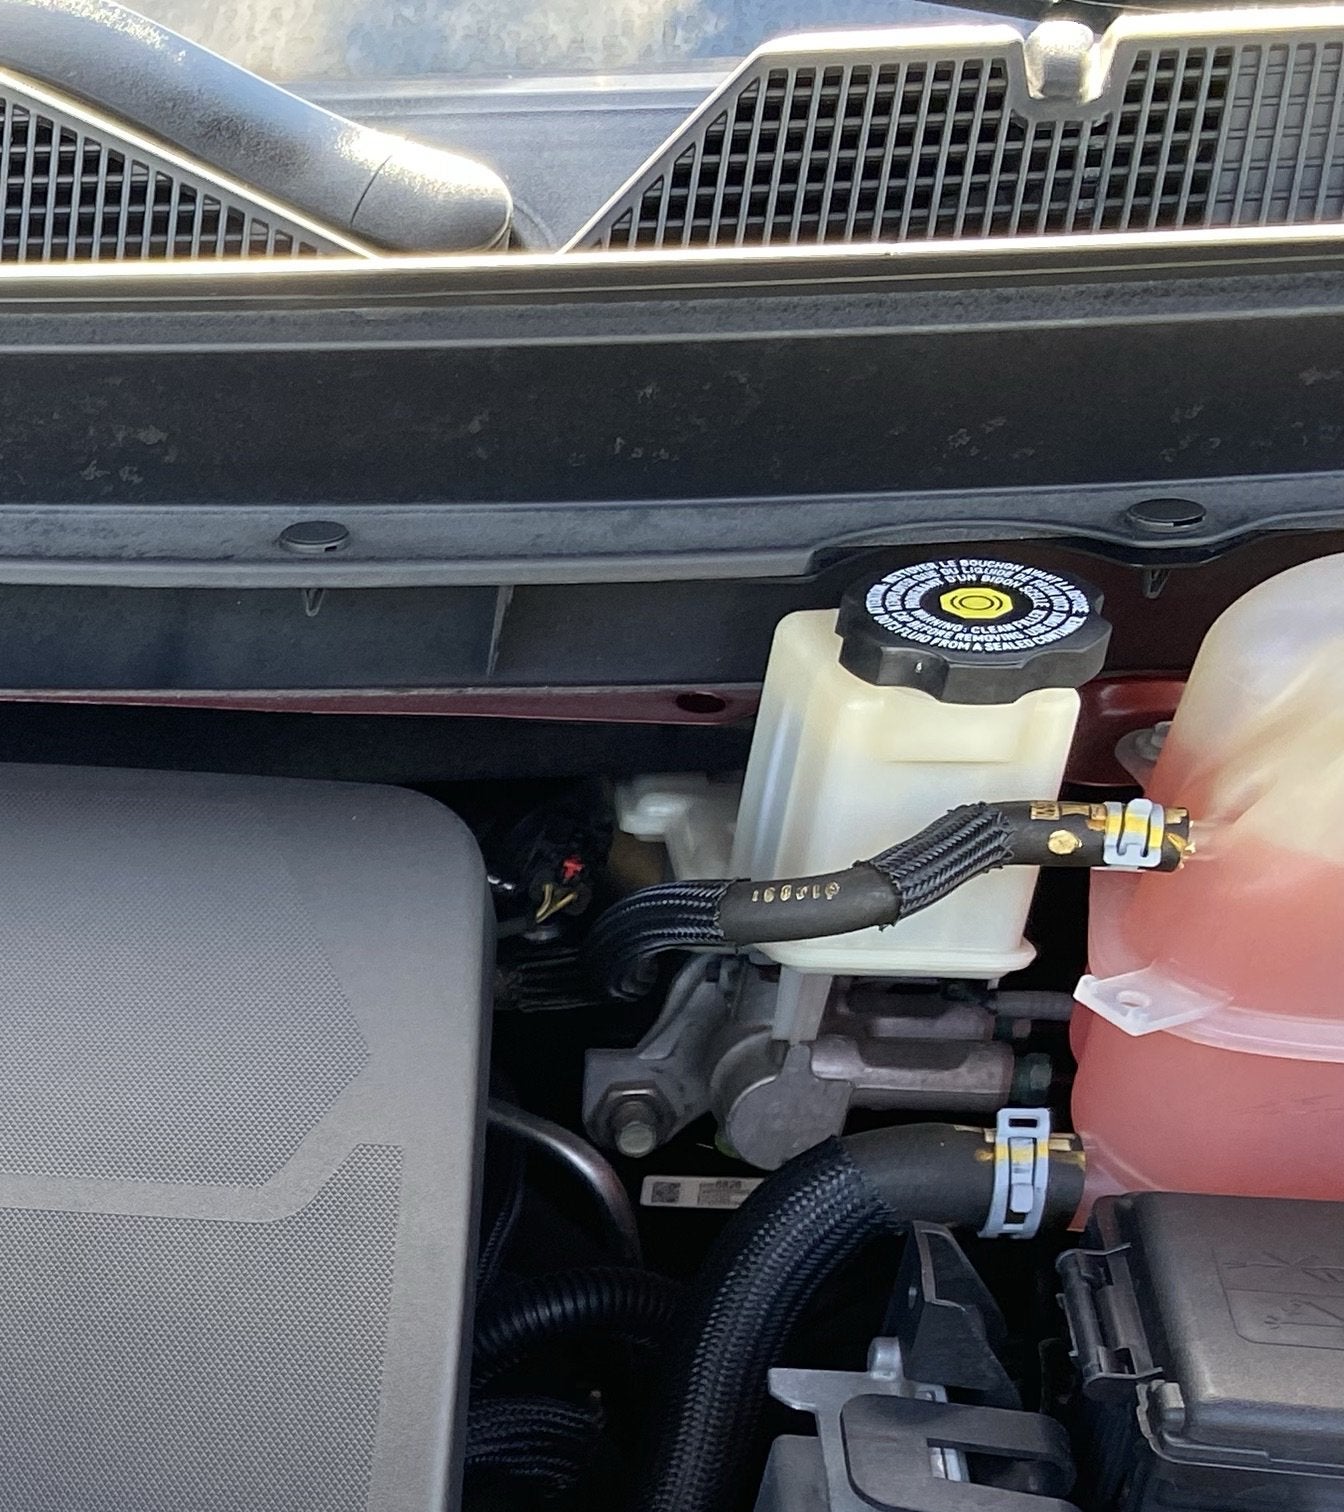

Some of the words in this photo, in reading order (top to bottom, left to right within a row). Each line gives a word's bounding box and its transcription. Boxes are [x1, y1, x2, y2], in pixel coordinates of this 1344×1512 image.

[960, 560, 1020, 572] BOUCHON
[1021, 567, 1063, 582] AVANT
[909, 621, 954, 639] BEFORE
[971, 622, 1015, 633] CLEAN
[896, 627, 933, 644] FLUID
[931, 636, 970, 650] FROM
[984, 638, 1037, 651] SEALED
